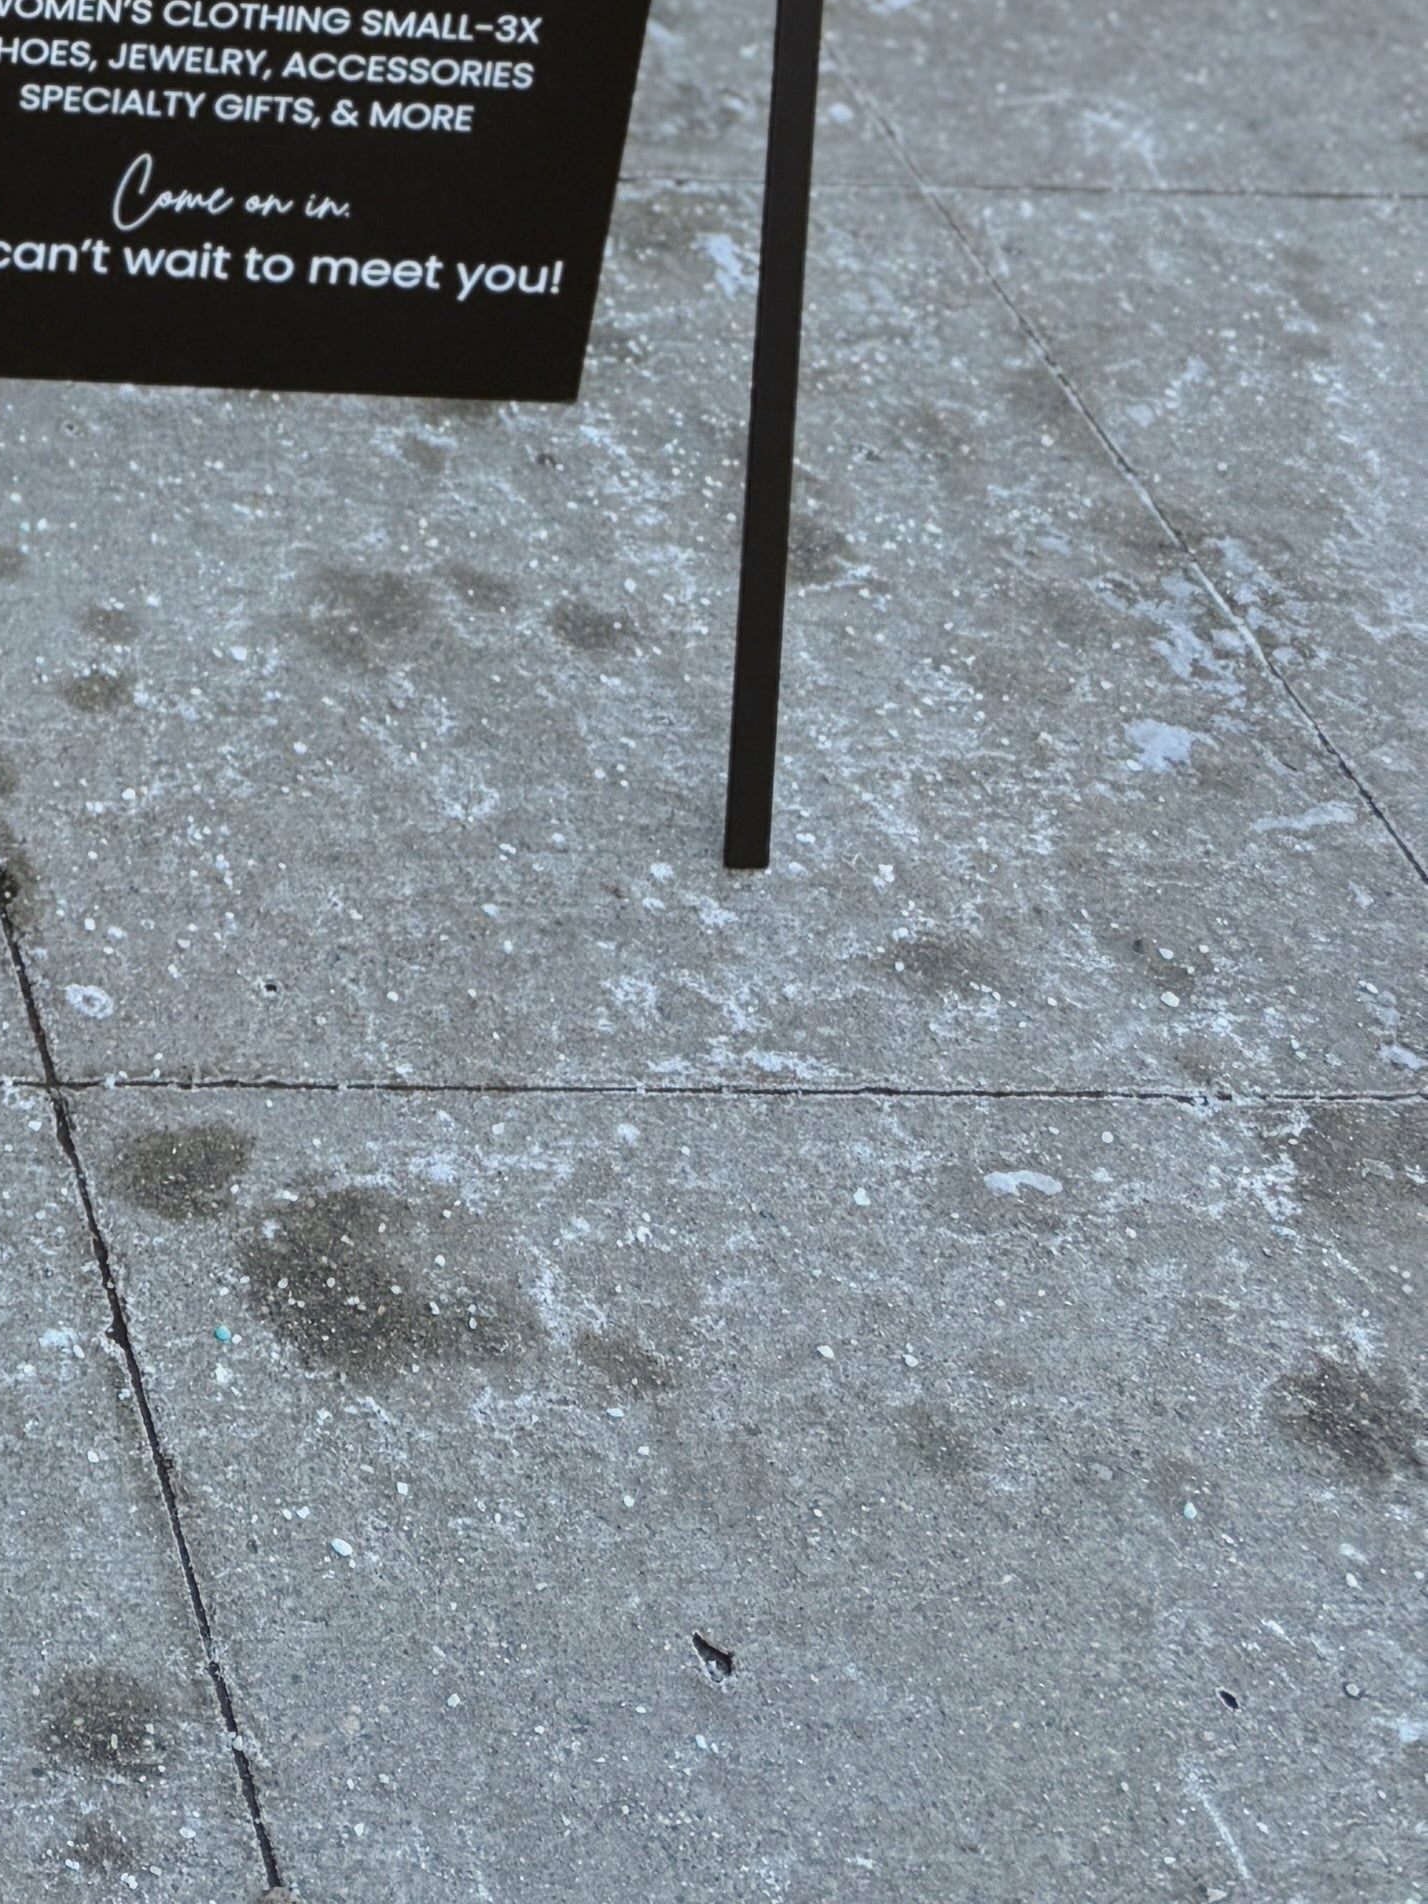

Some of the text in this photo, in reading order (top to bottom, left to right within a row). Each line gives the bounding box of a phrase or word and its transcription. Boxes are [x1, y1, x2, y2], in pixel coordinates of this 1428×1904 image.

[162, 0, 352, 35] CLOTHING
[360, 8, 543, 45] SMALL-3X
[107, 42, 272, 81] JEWELRY,
[281, 51, 535, 90] ACCESSORIES
[19, 83, 475, 132] SPECIALTY GIFTS, & MORE
[112, 152, 234, 231] Come
[244, 194, 294, 217] on
[123, 241, 232, 280] wait
[244, 246, 295, 283] to
[308, 251, 444, 290] meet
[456, 260, 564, 302] you!
